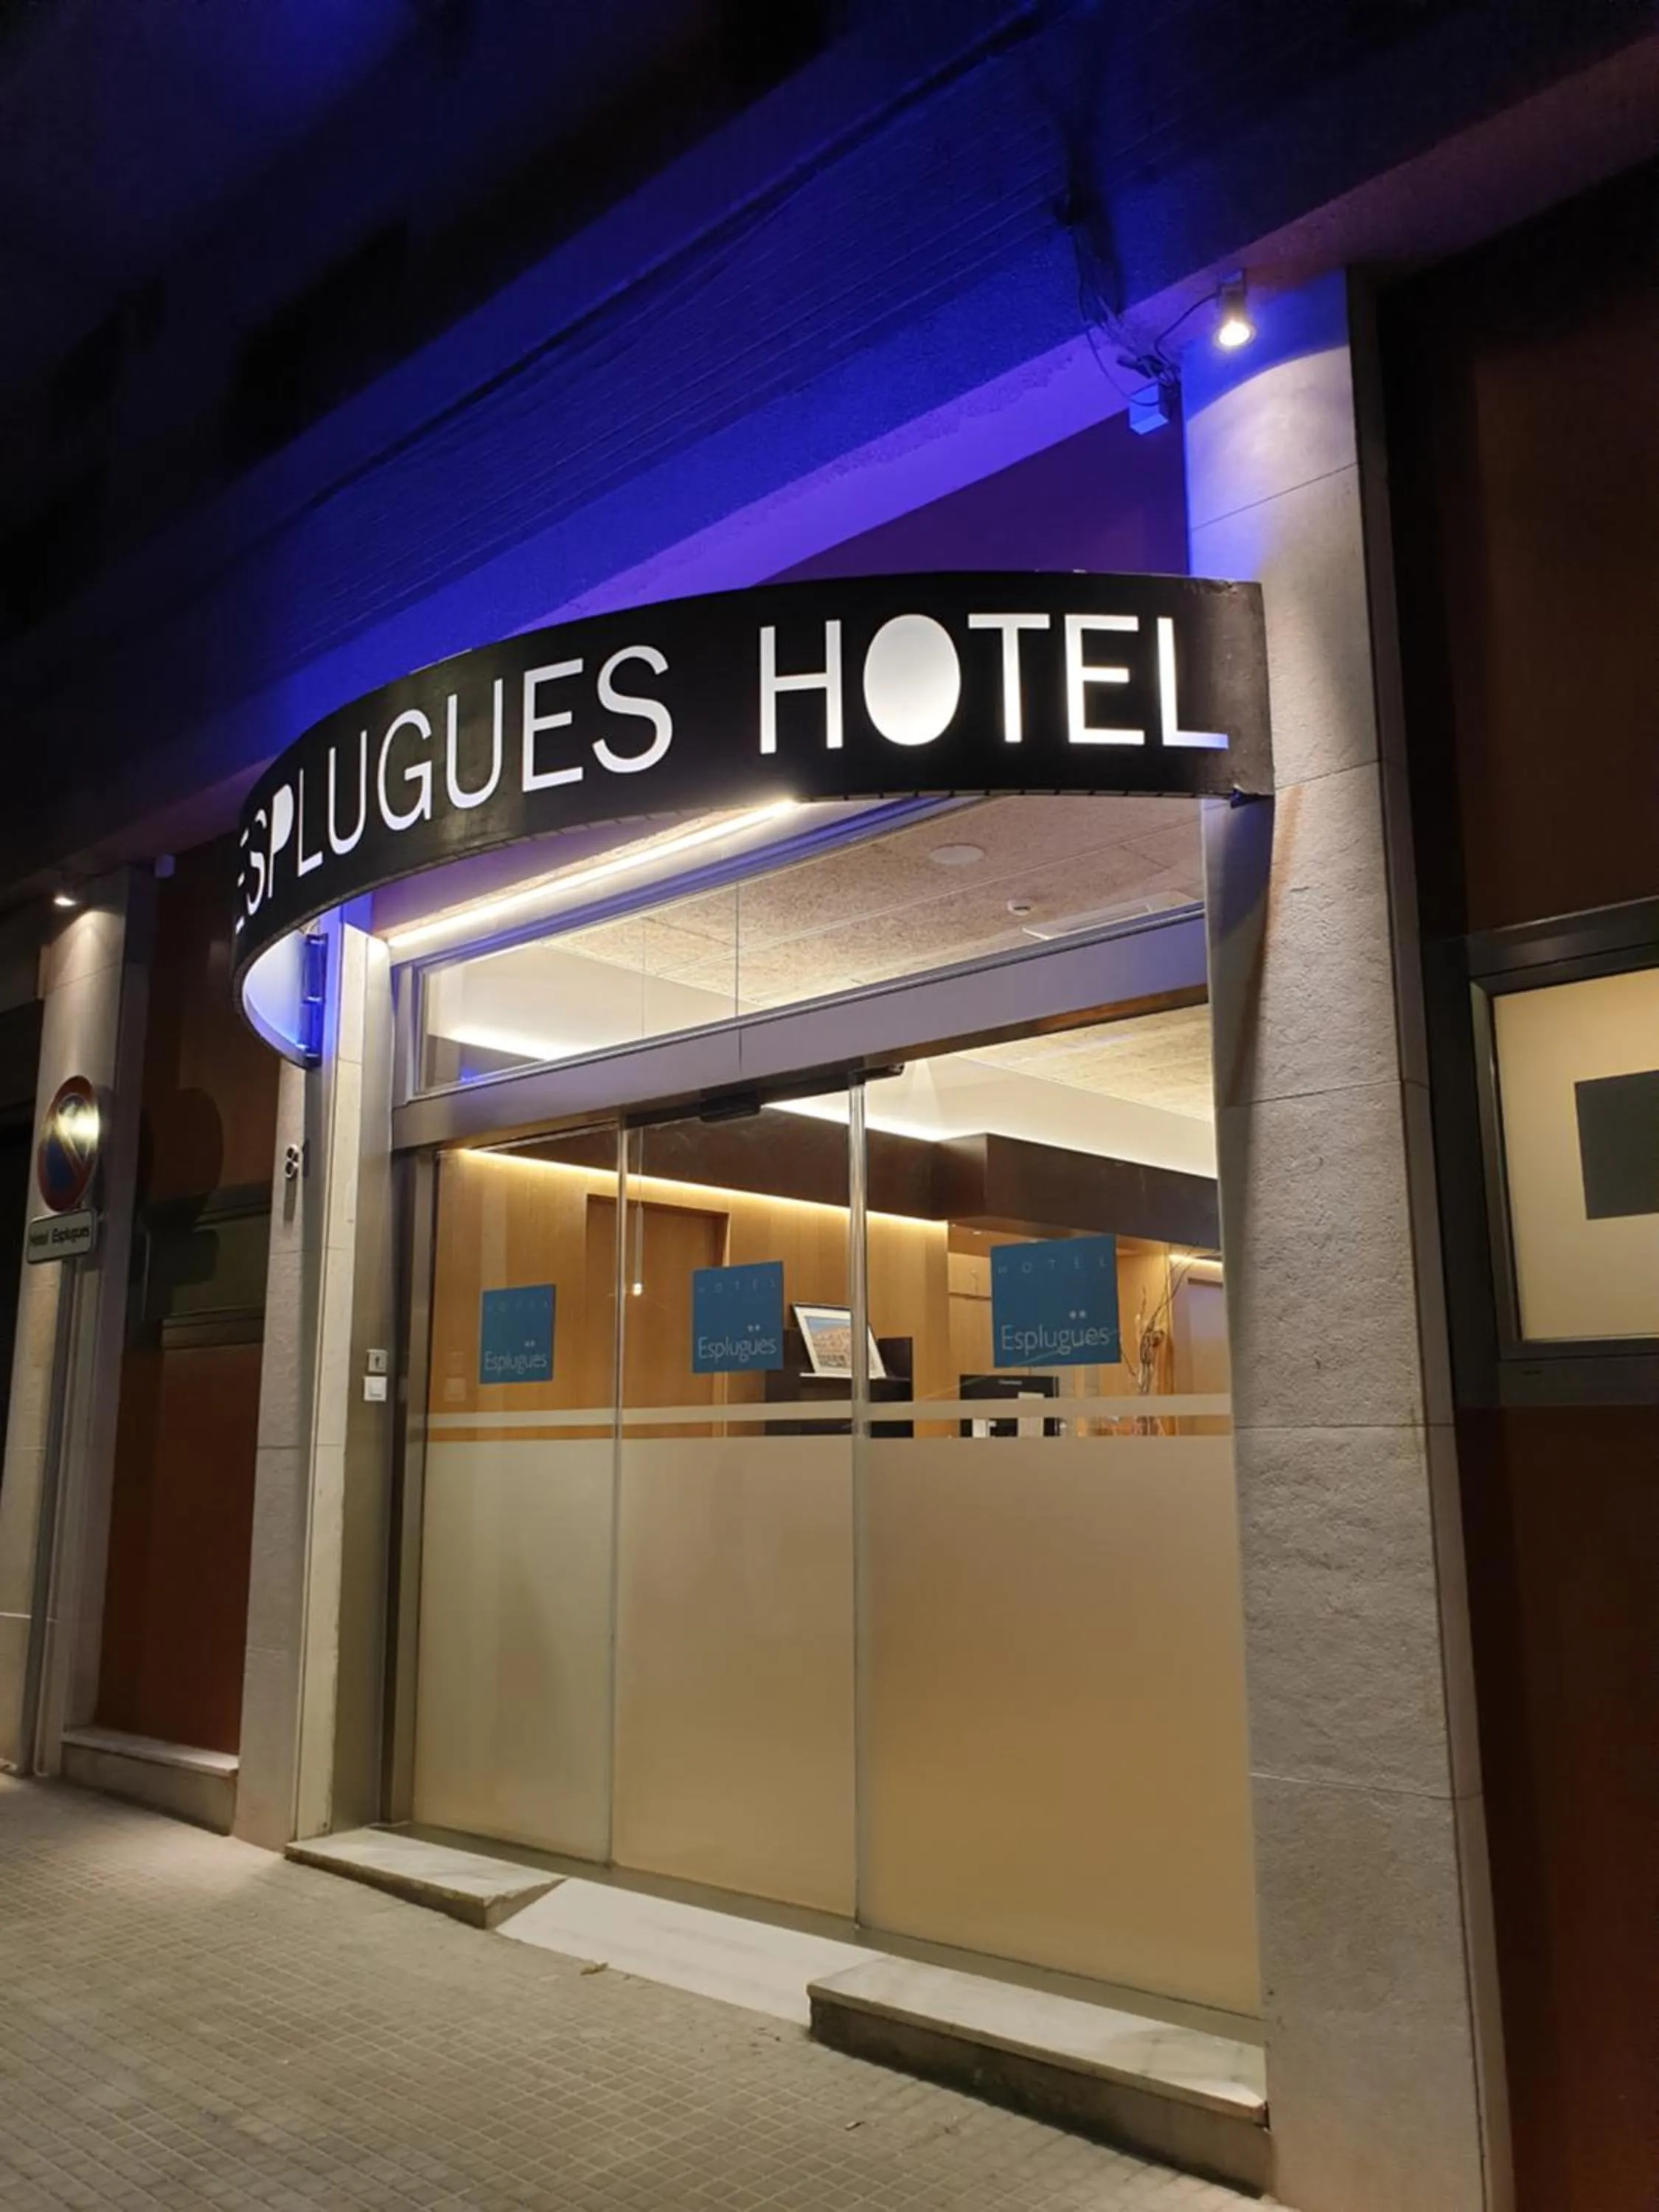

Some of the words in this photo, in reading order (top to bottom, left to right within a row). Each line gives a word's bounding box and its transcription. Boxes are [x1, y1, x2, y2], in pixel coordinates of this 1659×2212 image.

[759, 613, 1228, 754] HOTEL
[698, 1329, 777, 1363] Esplugues
[1001, 1323, 1110, 1356] Esplugues
[484, 1350, 548, 1377] Esplugues
